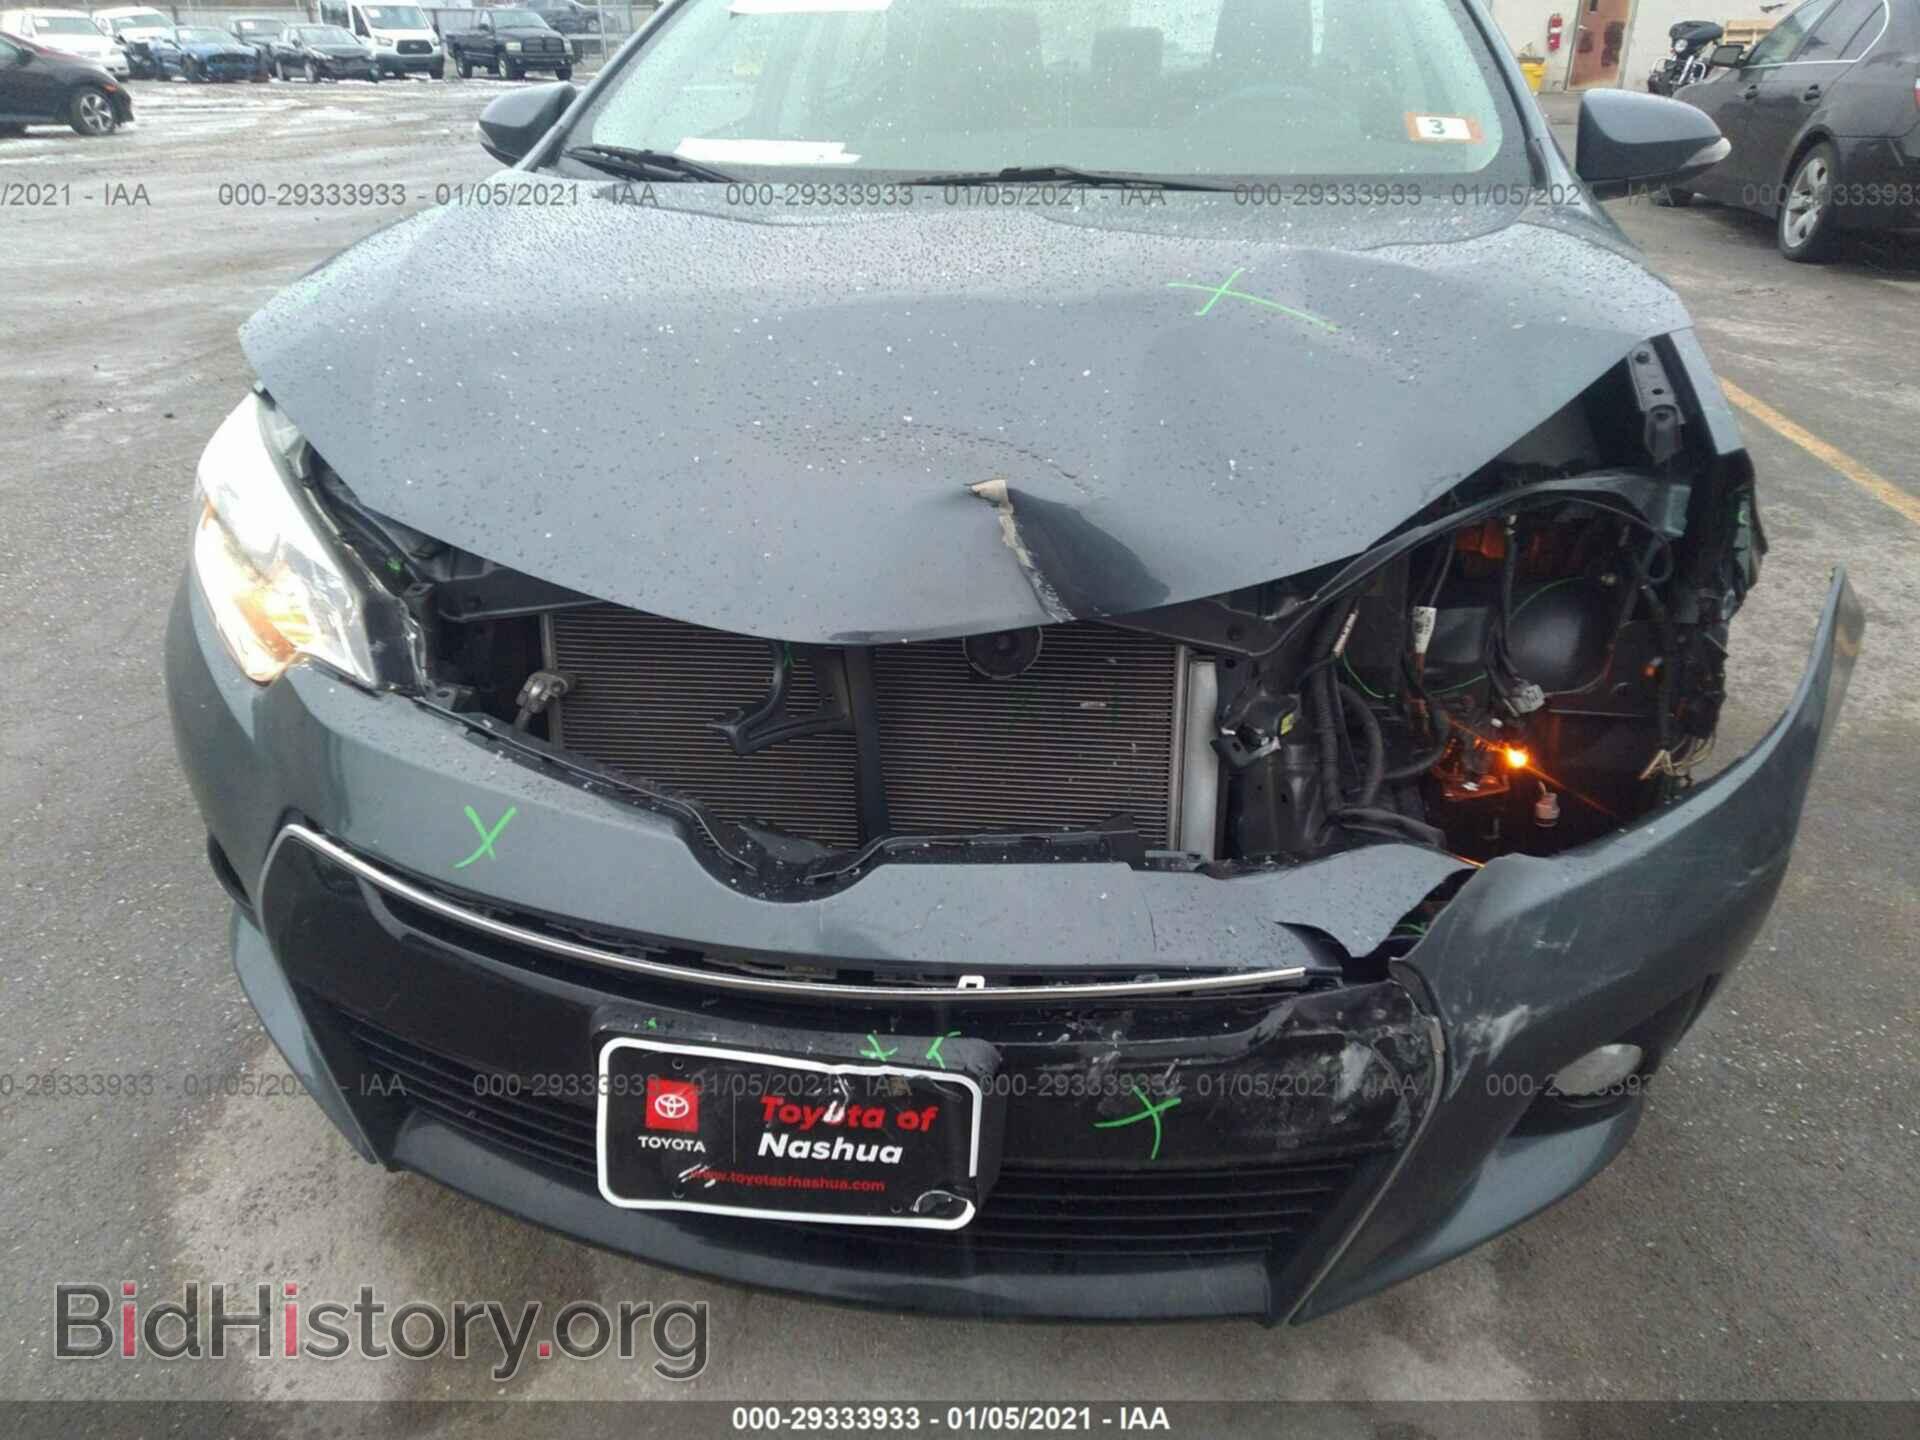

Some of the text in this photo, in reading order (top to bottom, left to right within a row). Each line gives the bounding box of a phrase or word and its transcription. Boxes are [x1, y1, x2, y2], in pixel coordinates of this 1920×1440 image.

[1428, 118, 1446, 136] 3
[760, 1095, 939, 1132] Toyota of
[637, 1135, 706, 1153] TOYOTA
[757, 1132, 903, 1164] Nashua
